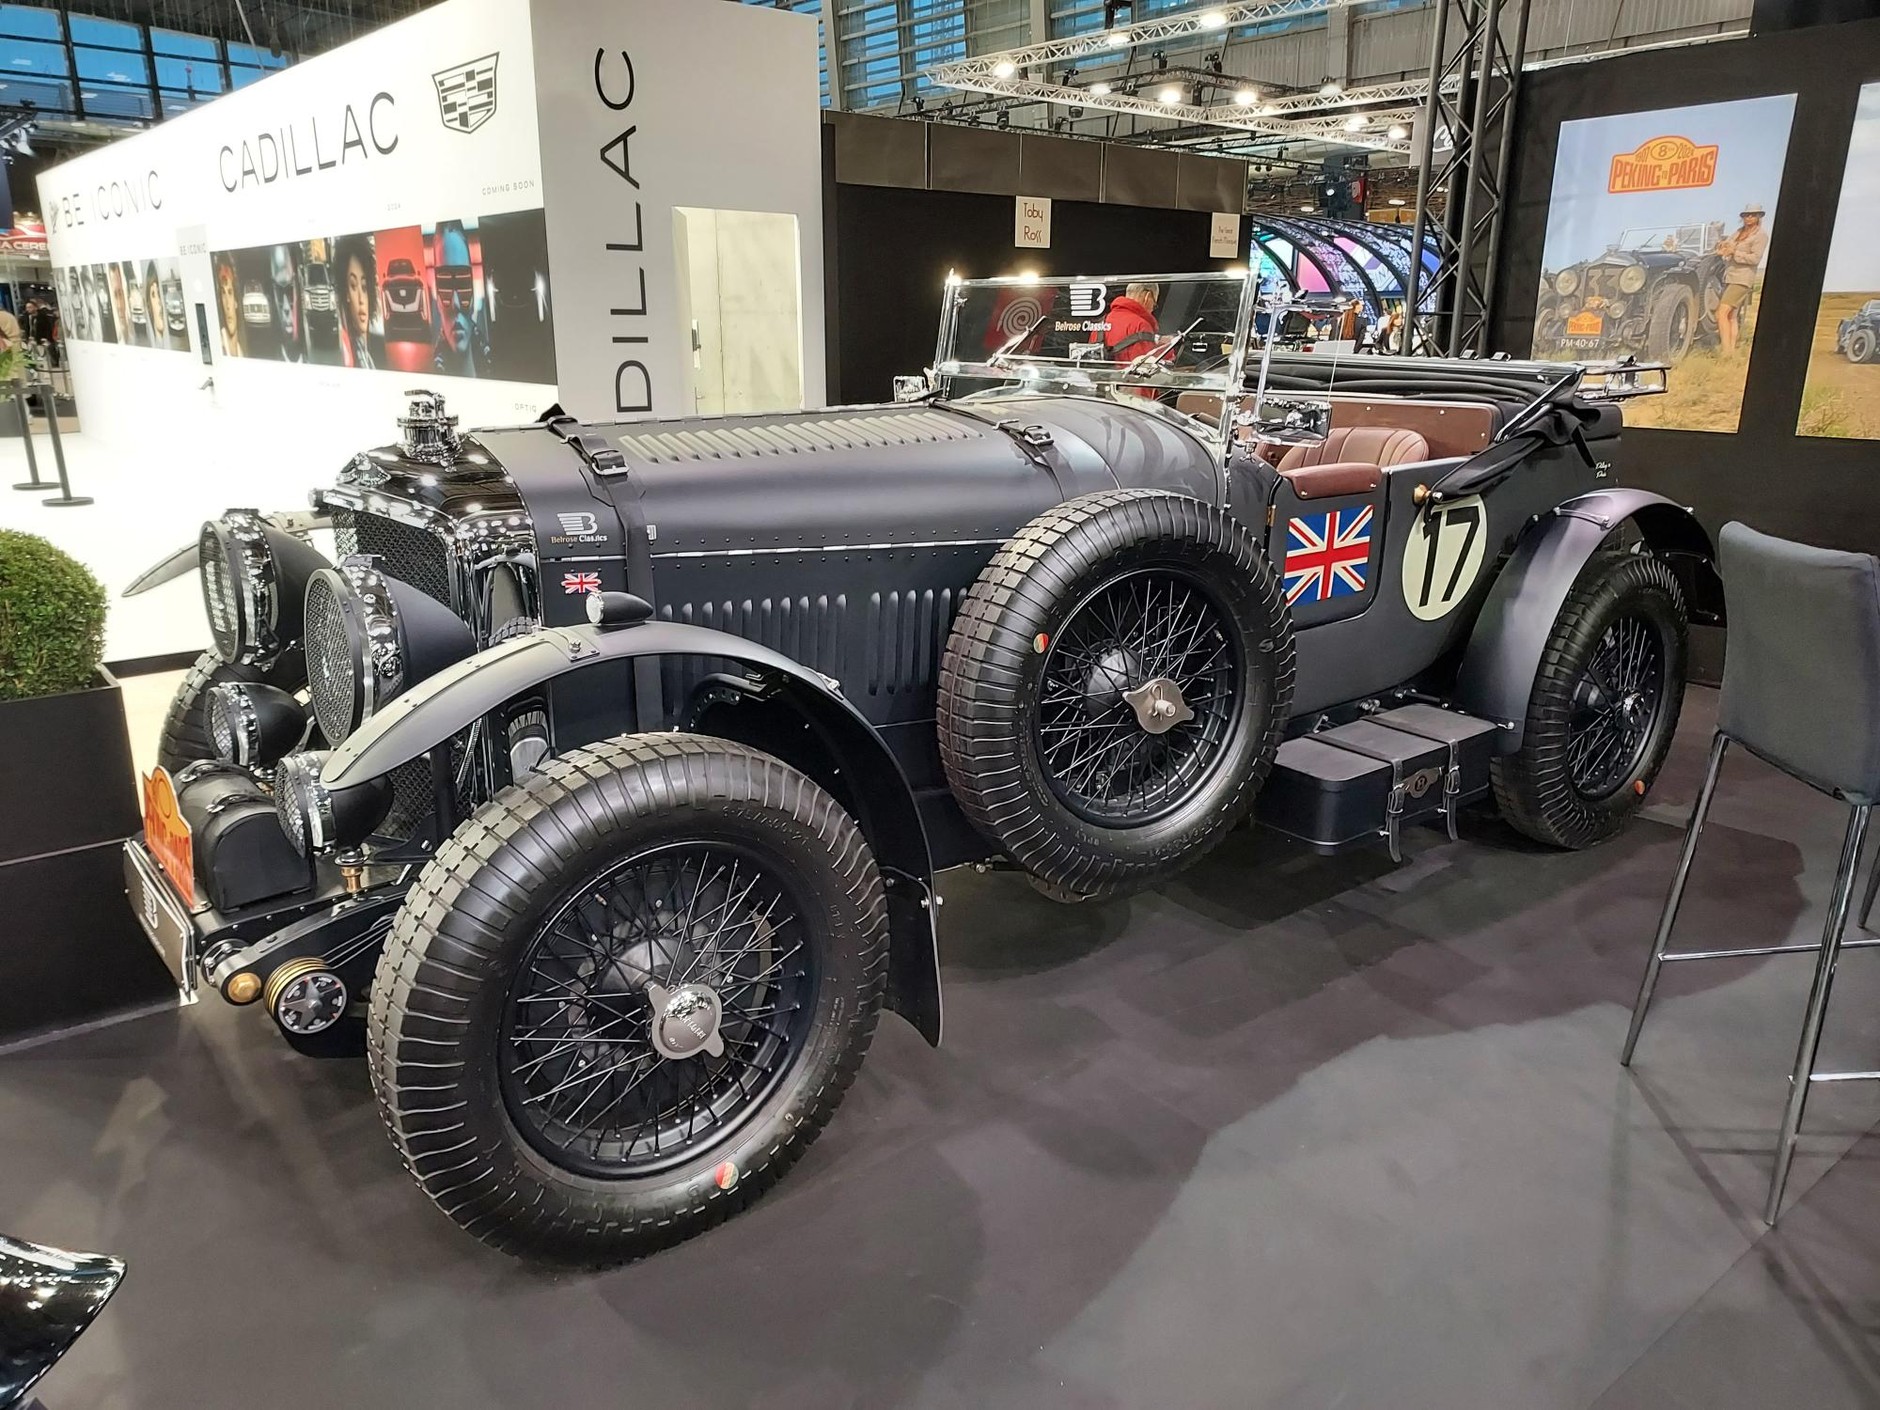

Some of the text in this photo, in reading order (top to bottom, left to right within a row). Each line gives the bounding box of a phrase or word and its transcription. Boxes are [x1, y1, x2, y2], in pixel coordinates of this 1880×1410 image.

[219, 91, 399, 193] CADILLAC
[1611, 159, 1662, 190] PEKING
[1667, 150, 1715, 186] PARIS
[481, 179, 535, 196] COMING SOON
[62, 170, 162, 228] BE ICONIC
[1023, 202, 1044, 223] Toby
[1023, 225, 1043, 243] Ross
[1054, 320, 1112, 332] Belrose Classics
[550, 534, 608, 544] Belrose Classics
[1418, 505, 1481, 607] 17
